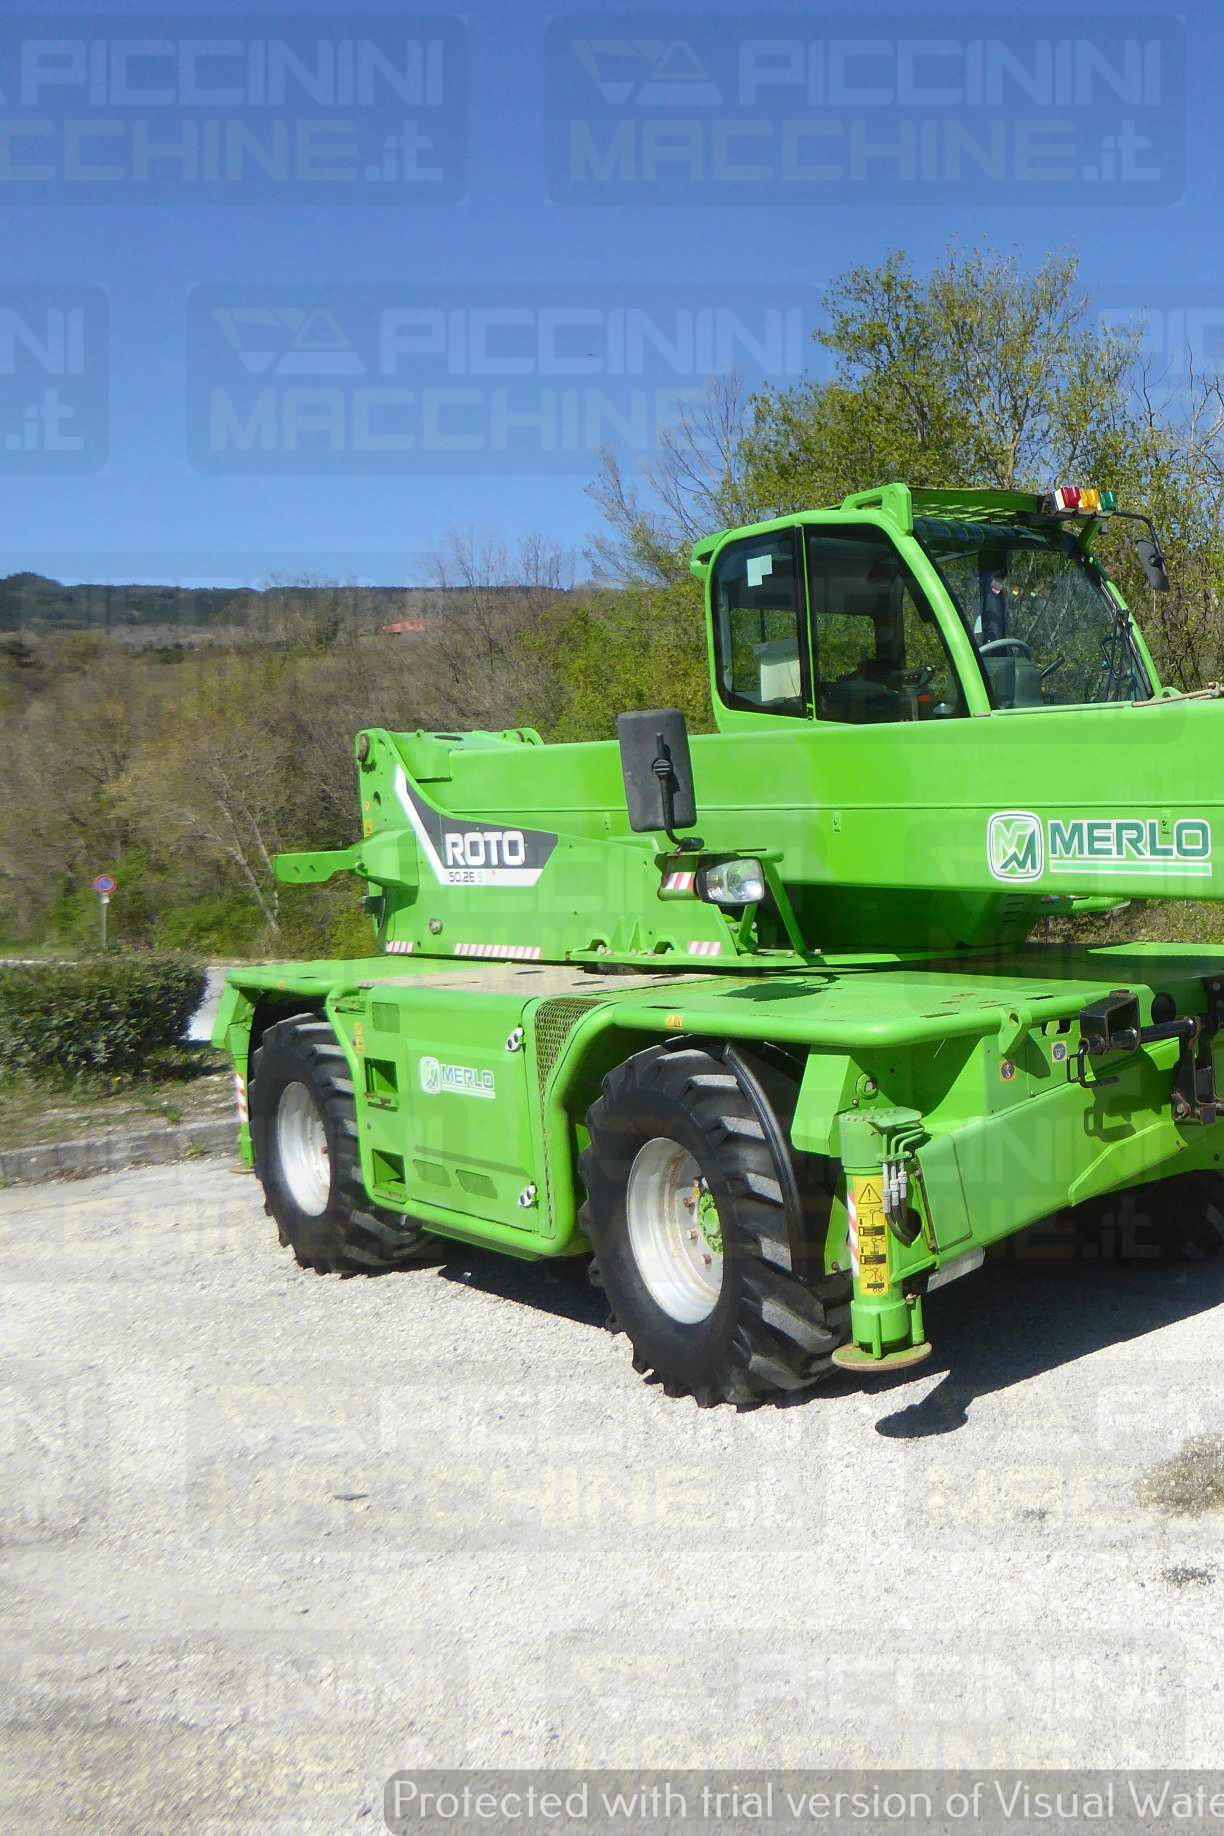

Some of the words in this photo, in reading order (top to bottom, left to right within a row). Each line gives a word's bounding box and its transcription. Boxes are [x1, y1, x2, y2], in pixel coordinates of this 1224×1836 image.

[444, 830, 526, 866] ROTO
[1049, 820, 1211, 858] MERLO
[441, 1064, 494, 1089] MERLO
